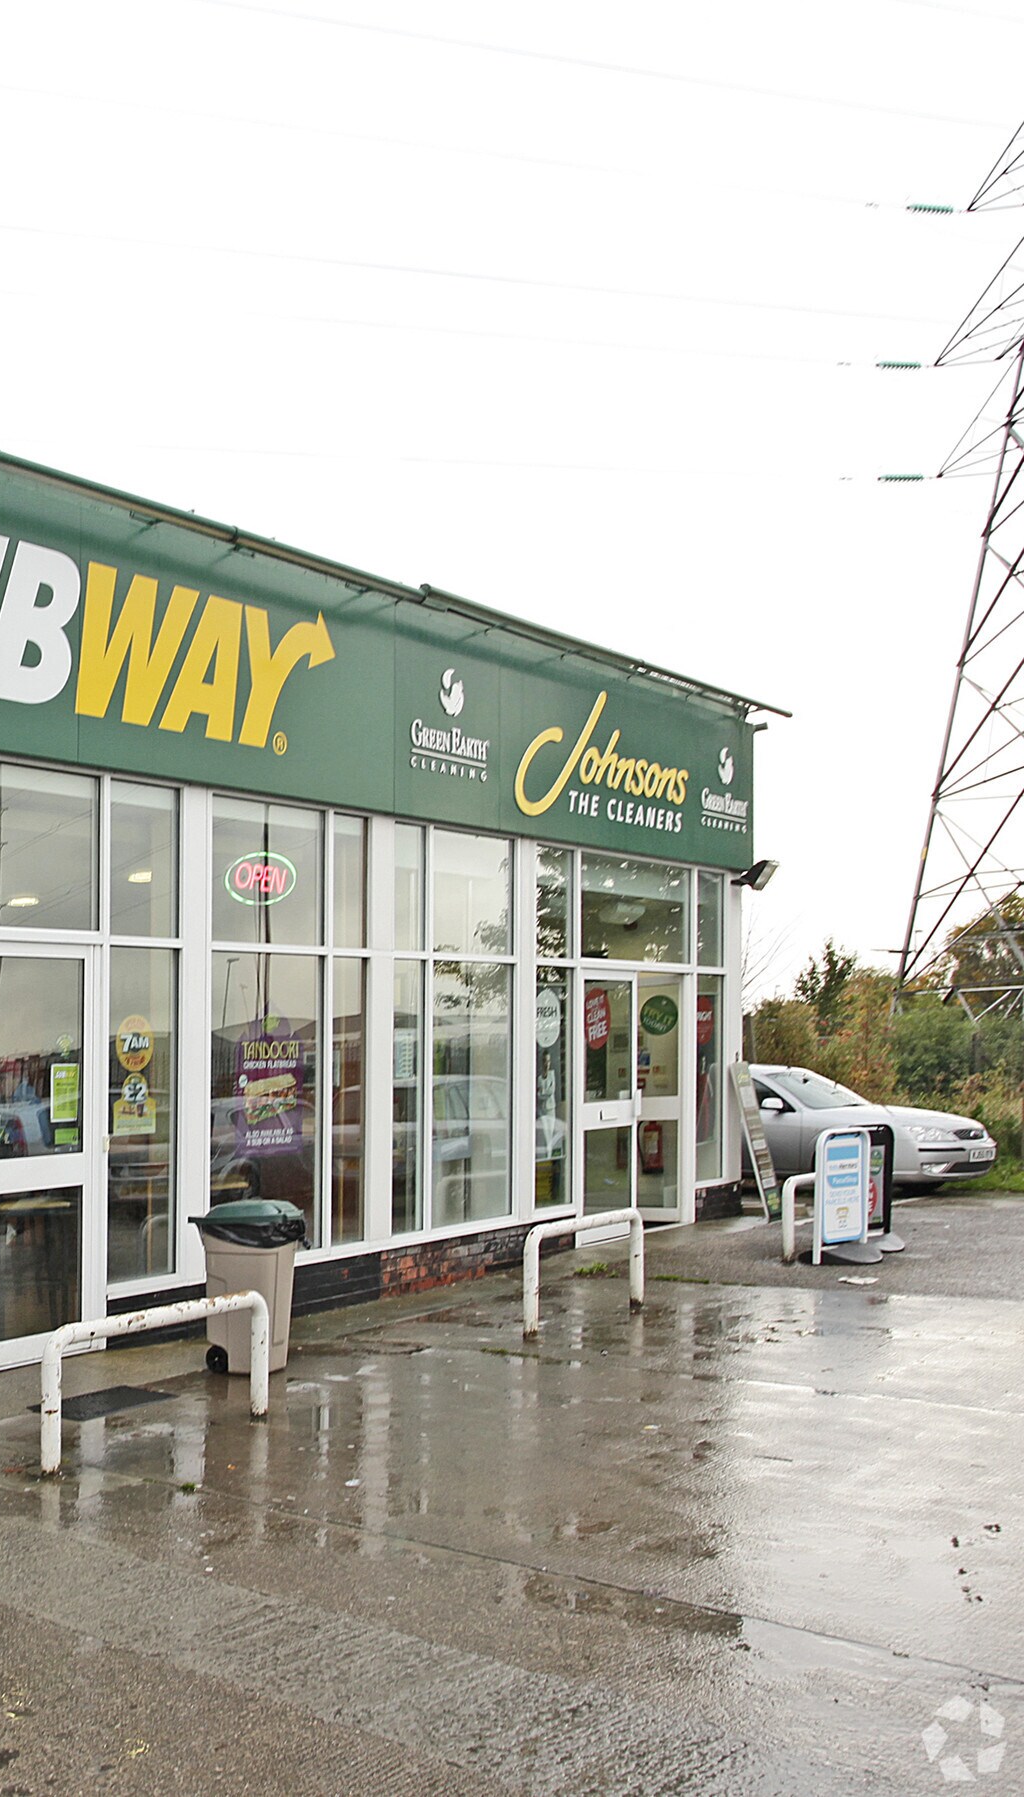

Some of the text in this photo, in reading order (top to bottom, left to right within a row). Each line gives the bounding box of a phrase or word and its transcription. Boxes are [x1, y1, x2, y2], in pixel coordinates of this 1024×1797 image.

[515, 691, 689, 816] Johnsons
[410, 755, 488, 782] CLEANING
[568, 790, 682, 833] THE CLEANERS
[701, 815, 748, 835] CLEANING
[234, 862, 287, 894] OPEN
[241, 1040, 299, 1060] TANDOORI
[243, 1059, 266, 1070] CHICKEN
